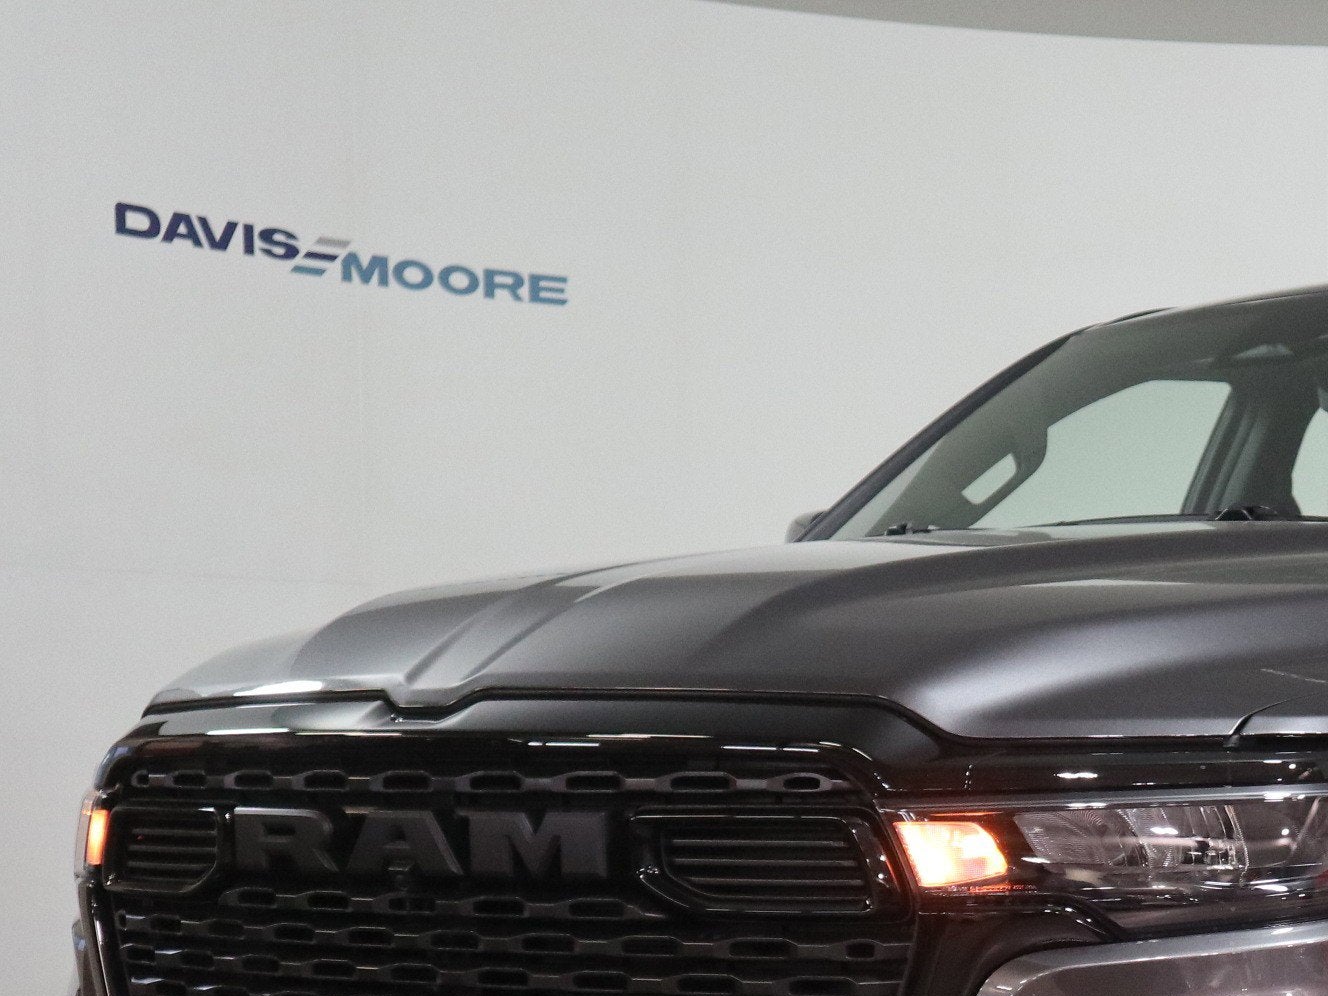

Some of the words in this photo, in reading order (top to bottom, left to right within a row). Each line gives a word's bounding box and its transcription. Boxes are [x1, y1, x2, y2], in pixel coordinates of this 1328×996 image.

[114, 202, 300, 261] DAVIS
[340, 250, 569, 306] MOORE
[232, 805, 611, 880] RAM
